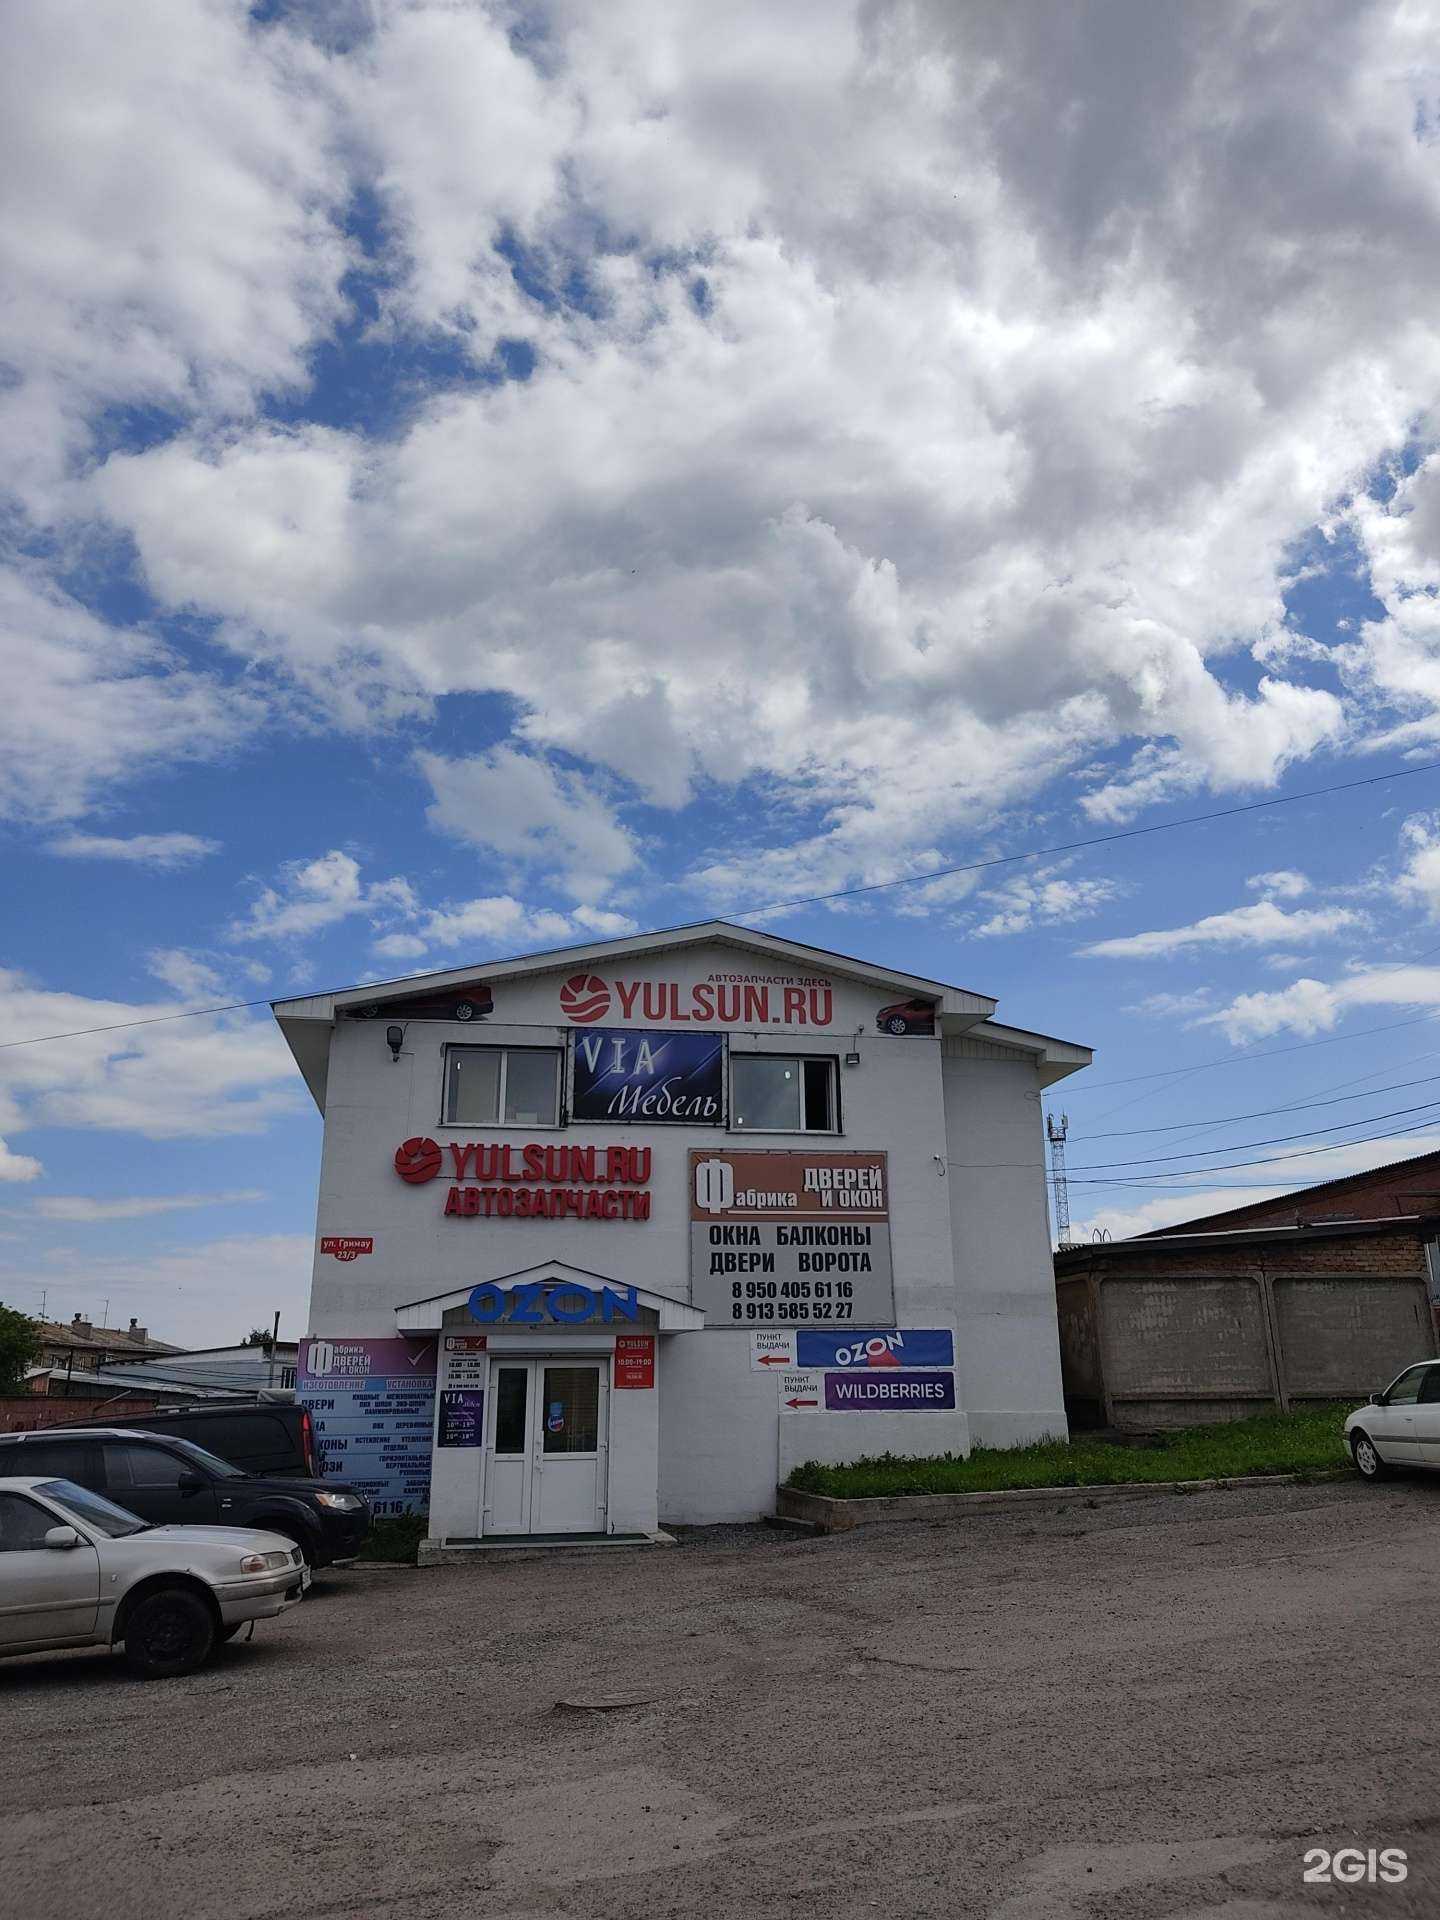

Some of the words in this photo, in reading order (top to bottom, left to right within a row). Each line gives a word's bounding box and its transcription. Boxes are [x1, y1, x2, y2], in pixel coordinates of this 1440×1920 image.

[707, 974, 794, 985] АВТОЗАПЧАСТИ
[798, 977, 832, 987] ЗДЕСЬ
[615, 982, 832, 1026] YULSUN.RU
[582, 1036, 655, 1075] VIA
[607, 1076, 718, 1117] Мебель
[449, 1143, 652, 1185] YULSUN.RU
[696, 1159, 798, 1214] Фабрика
[804, 1165, 882, 1192] ДВЕРЕЙ
[444, 1187, 651, 1221] АВТОЗАПЧАСТИ
[821, 1190, 832, 1207] И
[839, 1190, 883, 1207] ОКОН
[323, 1240, 336, 1248] ул.
[709, 1225, 761, 1245] ОКНА
[776, 1225, 871, 1246] БАЛКОНЫ
[337, 1251, 356, 1260] 23/3
[709, 1252, 775, 1275] ДВЕРИ
[798, 1252, 872, 1273] ВОРОТА
[732, 1281, 742, 1298] 8
[746, 1281, 777, 1298] 950
[780, 1281, 811, 1298] 405
[814, 1281, 832, 1298] 61
[835, 1281, 853, 1298] 16
[468, 1283, 639, 1323] OZON
[732, 1303, 742, 1319] 8
[746, 1303, 774, 1319] 913
[778, 1303, 809, 1319] 585
[813, 1303, 832, 1319] 52
[835, 1303, 852, 1319] 27
[756, 1342, 790, 1350] ВЫДАЧИ
[835, 1332, 905, 1366] OZON
[784, 1376, 809, 1384] ПУНКТ
[784, 1384, 818, 1392] ВЫДАЧИ
[444, 1393, 464, 1404] VIA
[836, 1383, 944, 1398] WILDBERRIES
